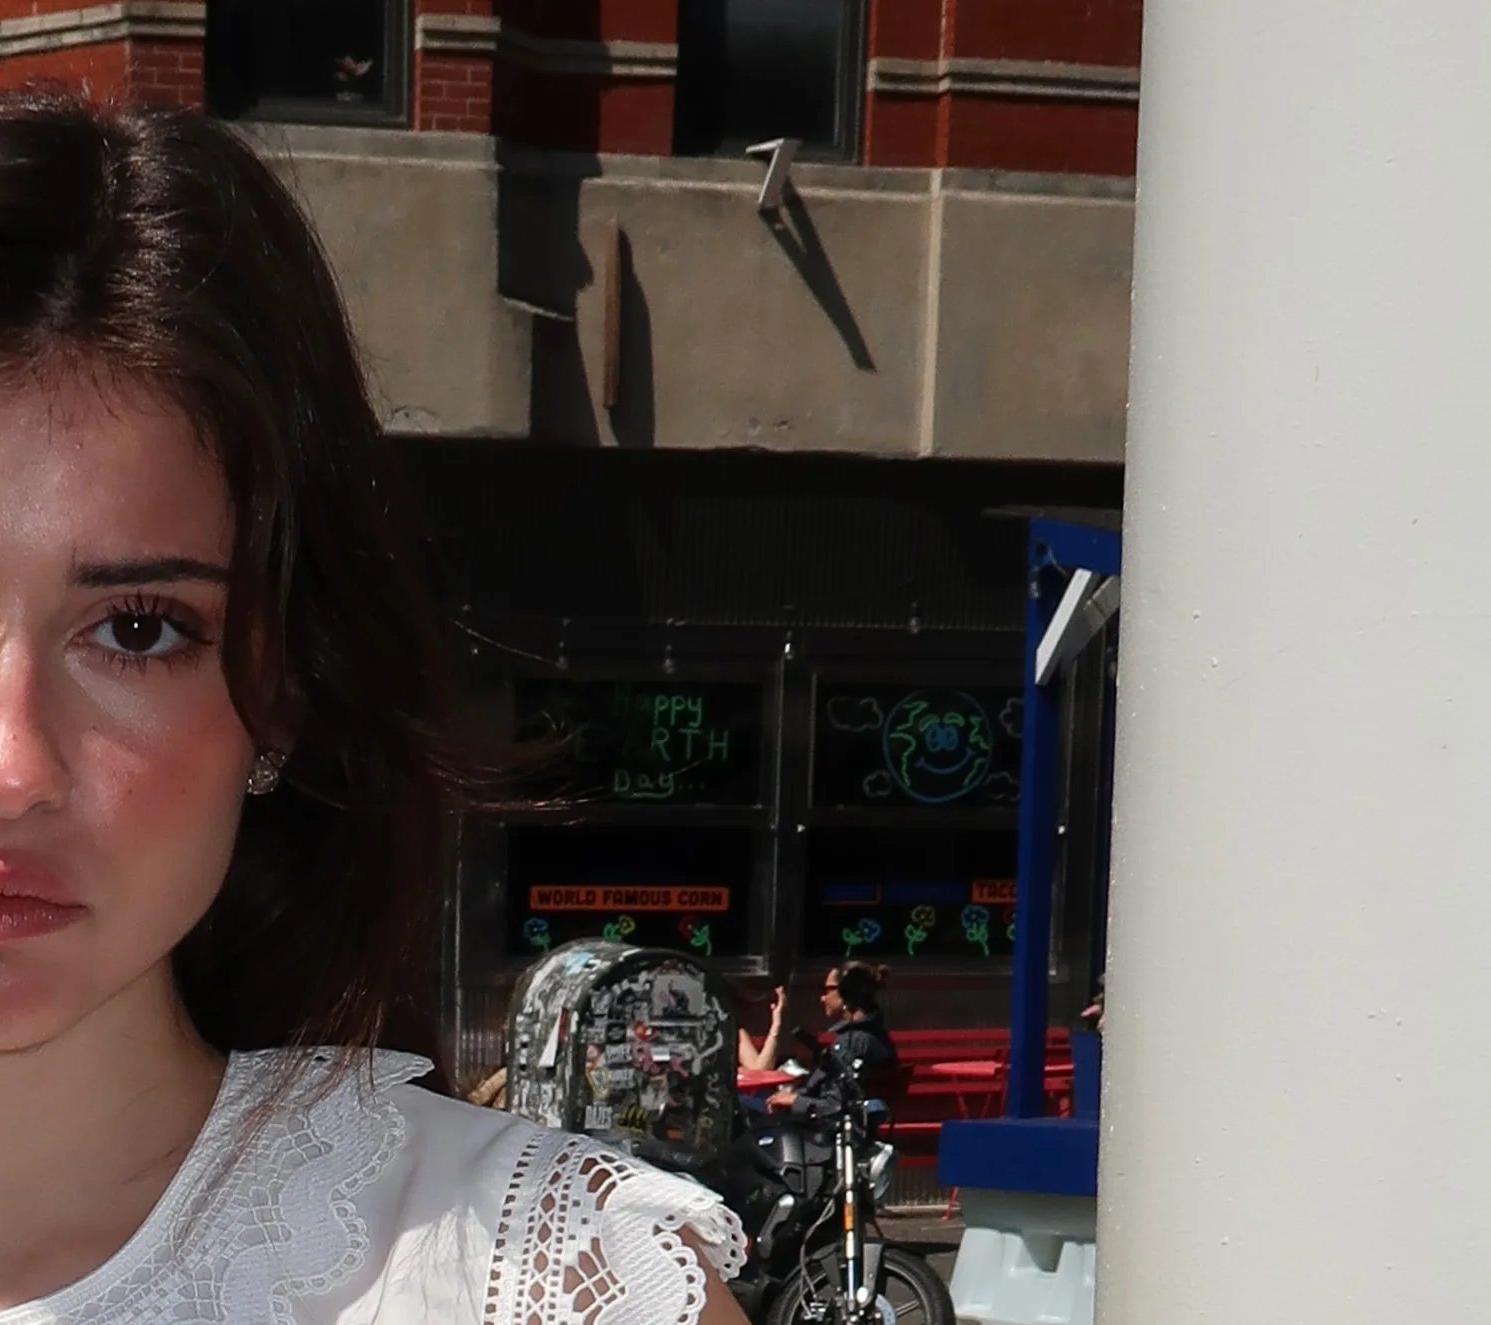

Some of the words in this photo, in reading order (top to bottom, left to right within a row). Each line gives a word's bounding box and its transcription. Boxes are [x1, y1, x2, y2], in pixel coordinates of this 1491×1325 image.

[537, 889, 597, 906] WORLD
[602, 889, 672, 906] FAMOUS
[677, 890, 723, 907] CORN
